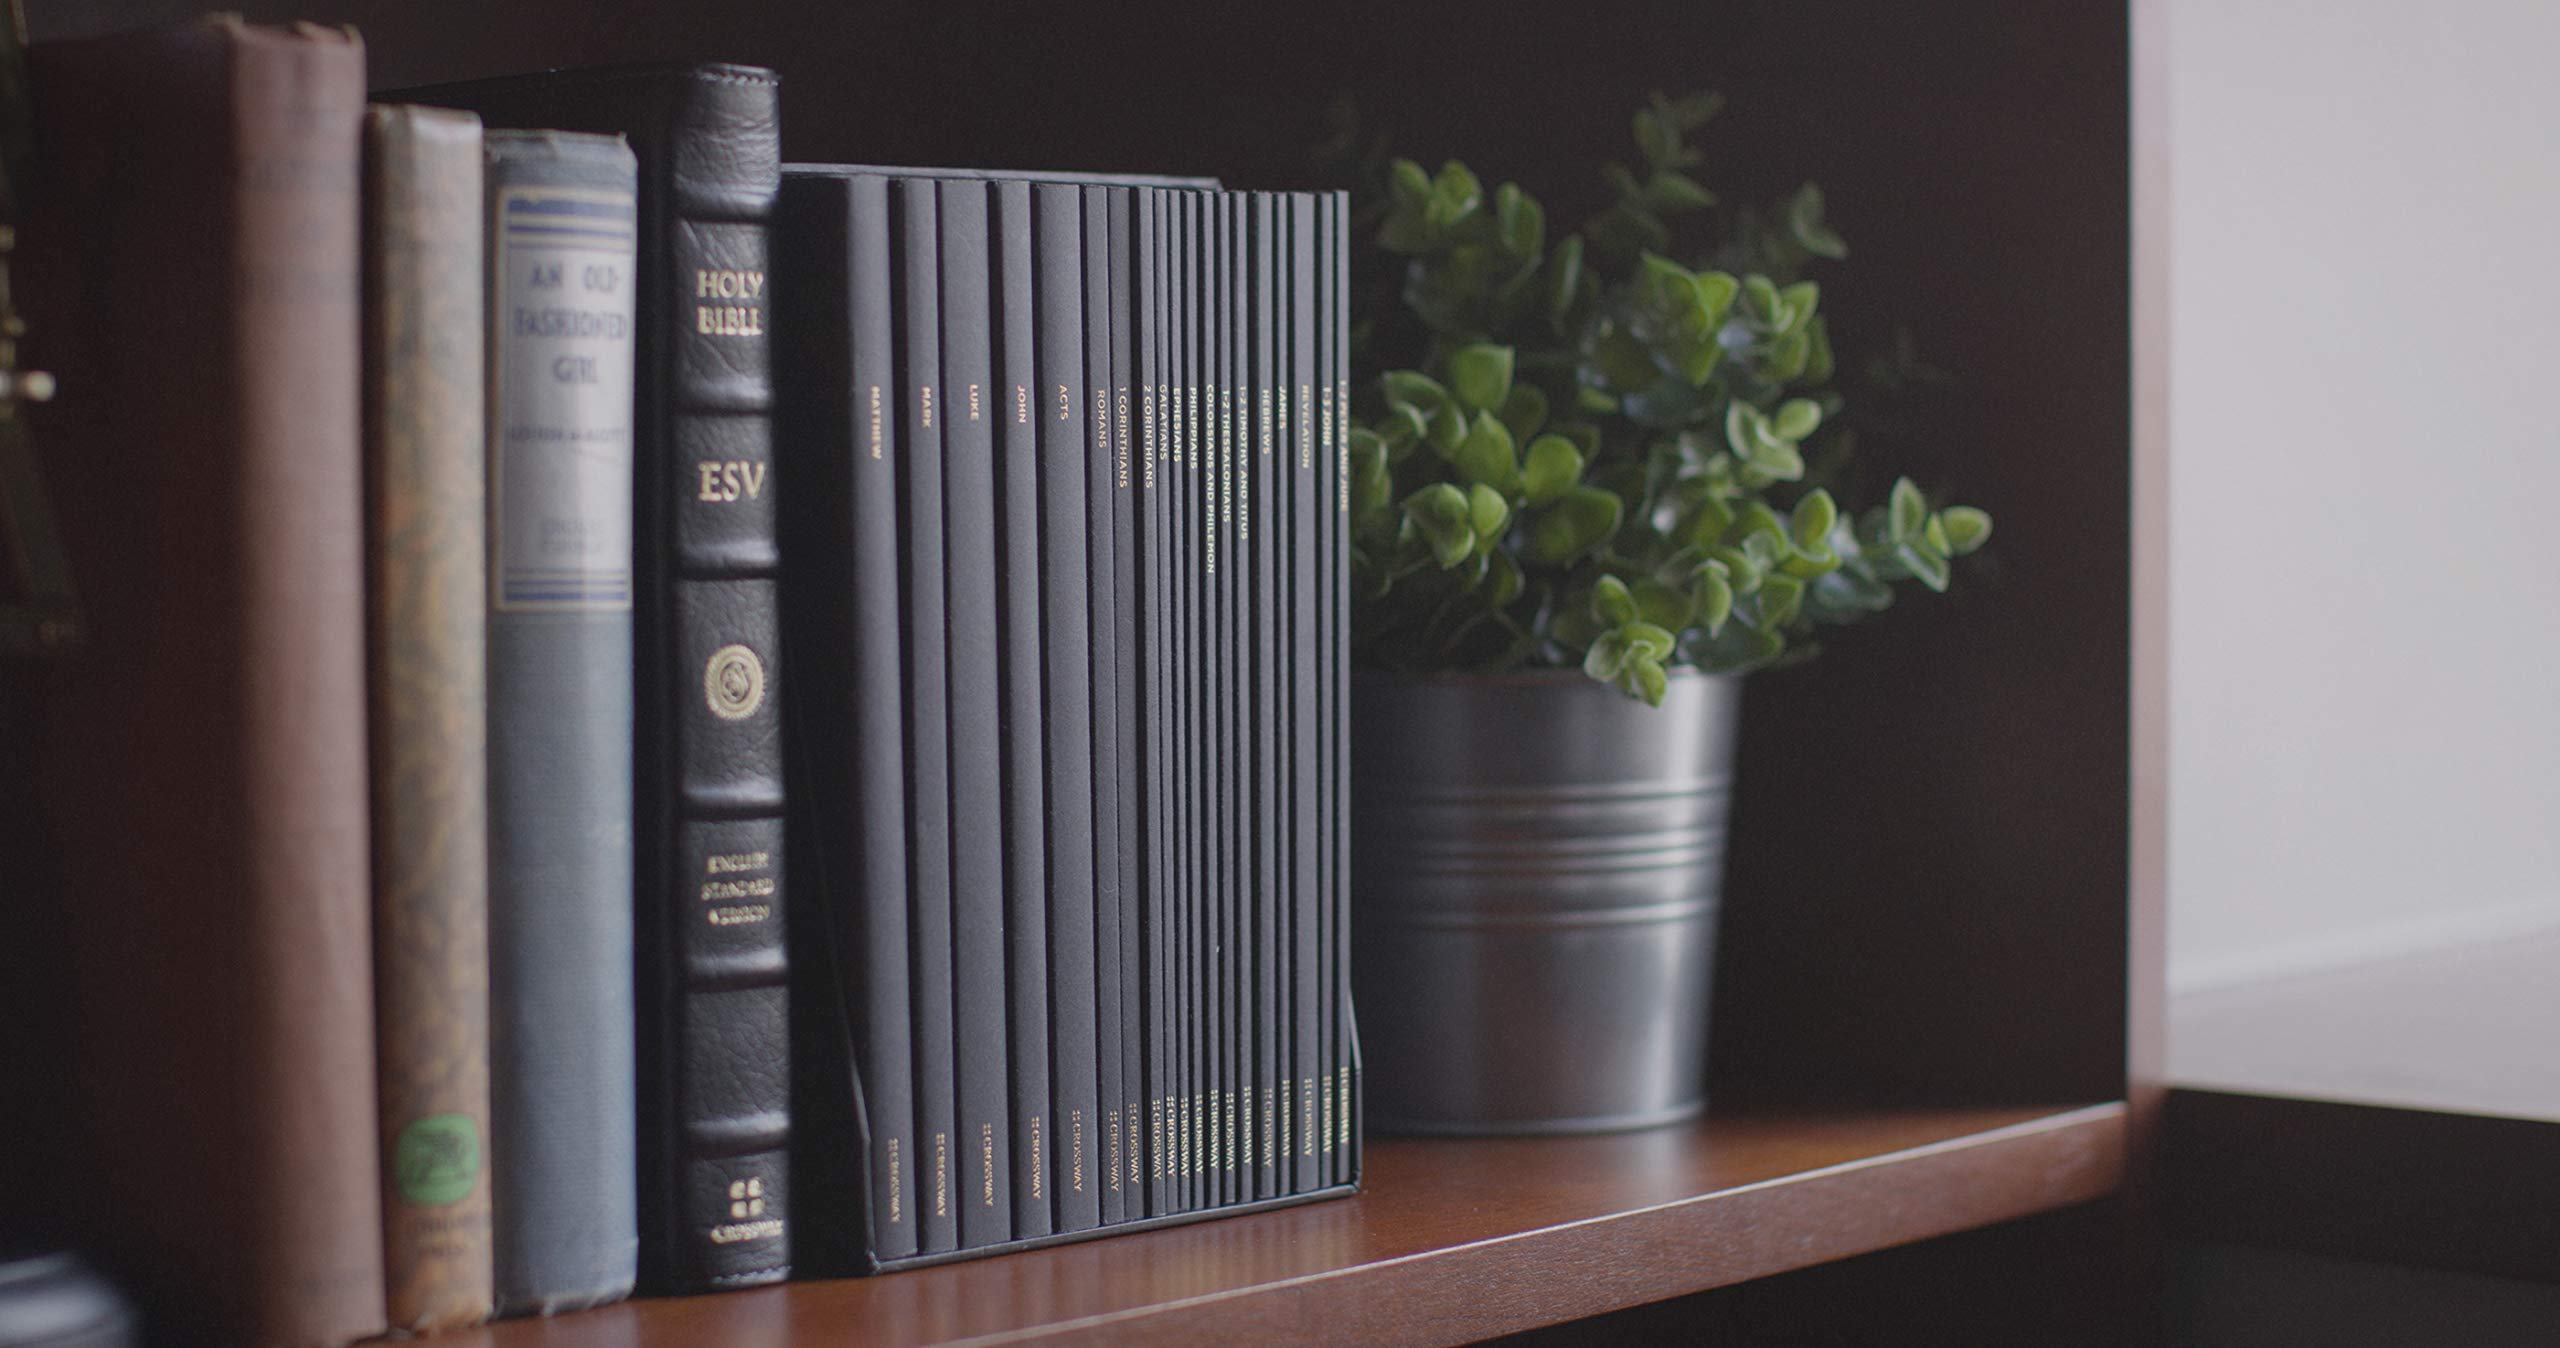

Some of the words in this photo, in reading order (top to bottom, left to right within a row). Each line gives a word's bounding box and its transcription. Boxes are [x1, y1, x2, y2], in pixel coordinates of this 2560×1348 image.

[530, 261, 562, 288] AN
[697, 270, 764, 298] HOLY
[514, 304, 626, 339] FASHIONED
[870, 385, 882, 460] MATTHEW
[921, 386, 932, 428] MARK
[969, 384, 980, 421] LUKE
[1017, 385, 1027, 424] JOHN
[1059, 384, 1069, 421] ACTS
[1097, 390, 1107, 449] ROMANS
[1159, 384, 1168, 461] GALATIANS
[1173, 387, 1182, 463] EPHESIANS
[1189, 387, 1198, 470] PHILIPPIANS
[1206, 384, 1215, 469] COLOSSIANS
[1262, 389, 1270, 455] HEBREWS
[1279, 386, 1287, 430] JAMES
[1302, 384, 1310, 469] REVELATION
[1322, 409, 1332, 446] JOHN
[1118, 395, 1128, 489] CORINTHIANS
[1144, 395, 1154, 489] CORINTHIANS
[1223, 412, 1232, 523] THESSALONIANS
[1240, 408, 1248, 467] TIMOTHY
[698, 461, 765, 501] ESV
[1207, 473, 1215, 501] AND
[1240, 470, 1248, 500] AND
[1207, 504, 1216, 574] PHILEMON
[1240, 503, 1248, 540] TITUS
[1031, 1129, 1041, 1199] CROSSWAY
[1072, 1123, 1082, 1192] CROSSWAY
[1110, 1124, 1119, 1192] CROSSWAY
[1129, 1116, 1139, 1184] CROSSWAY
[1153, 1112, 1162, 1181] CROSSWAY
[1166, 1109, 1176, 1177] CROSSWAY
[1181, 1110, 1189, 1178] CROSSWAY
[1195, 1107, 1204, 1174] CROSSWAY
[1210, 1102, 1219, 1169] CROSSWAY
[1226, 1105, 1235, 1172] CROSSWAY
[1244, 1098, 1252, 1165] CROSSWAY
[1264, 1101, 1272, 1168] CROSSWAY
[983, 1136, 993, 1207] CROSSWAY
